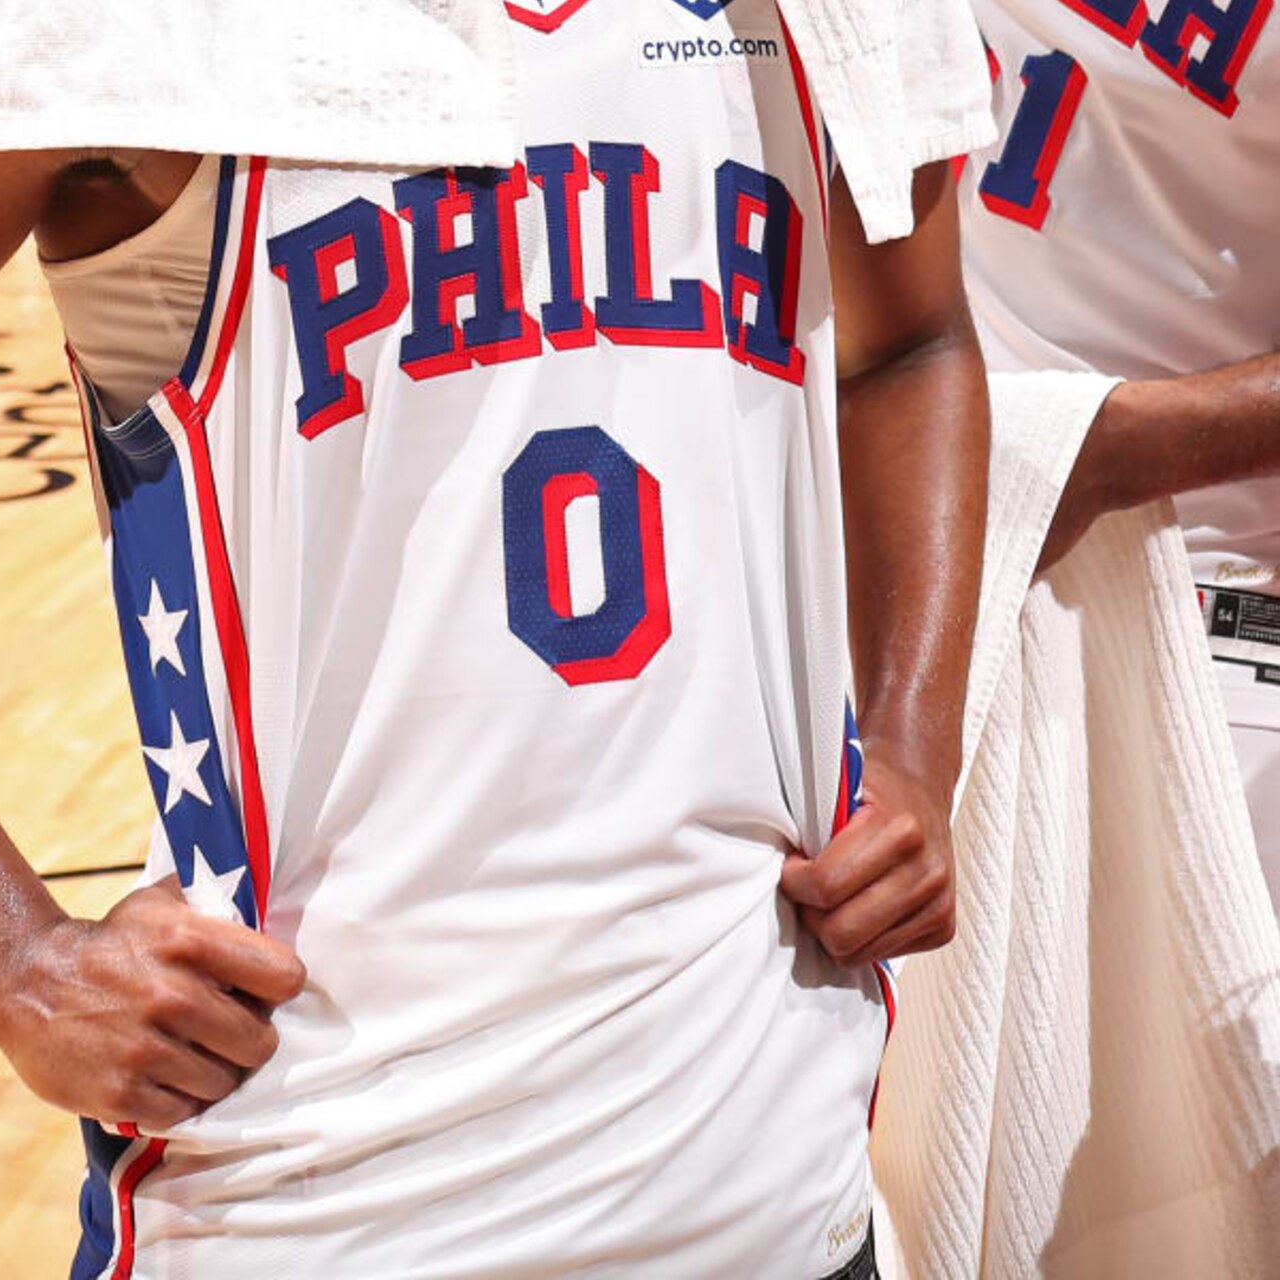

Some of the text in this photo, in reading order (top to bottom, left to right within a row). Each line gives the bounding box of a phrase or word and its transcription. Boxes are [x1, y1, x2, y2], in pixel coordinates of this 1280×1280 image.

[642, 36, 778, 62] crypto.com
[952, 30, 1089, 232] 1
[267, 140, 806, 441] PHILA
[502, 424, 672, 687] 0
